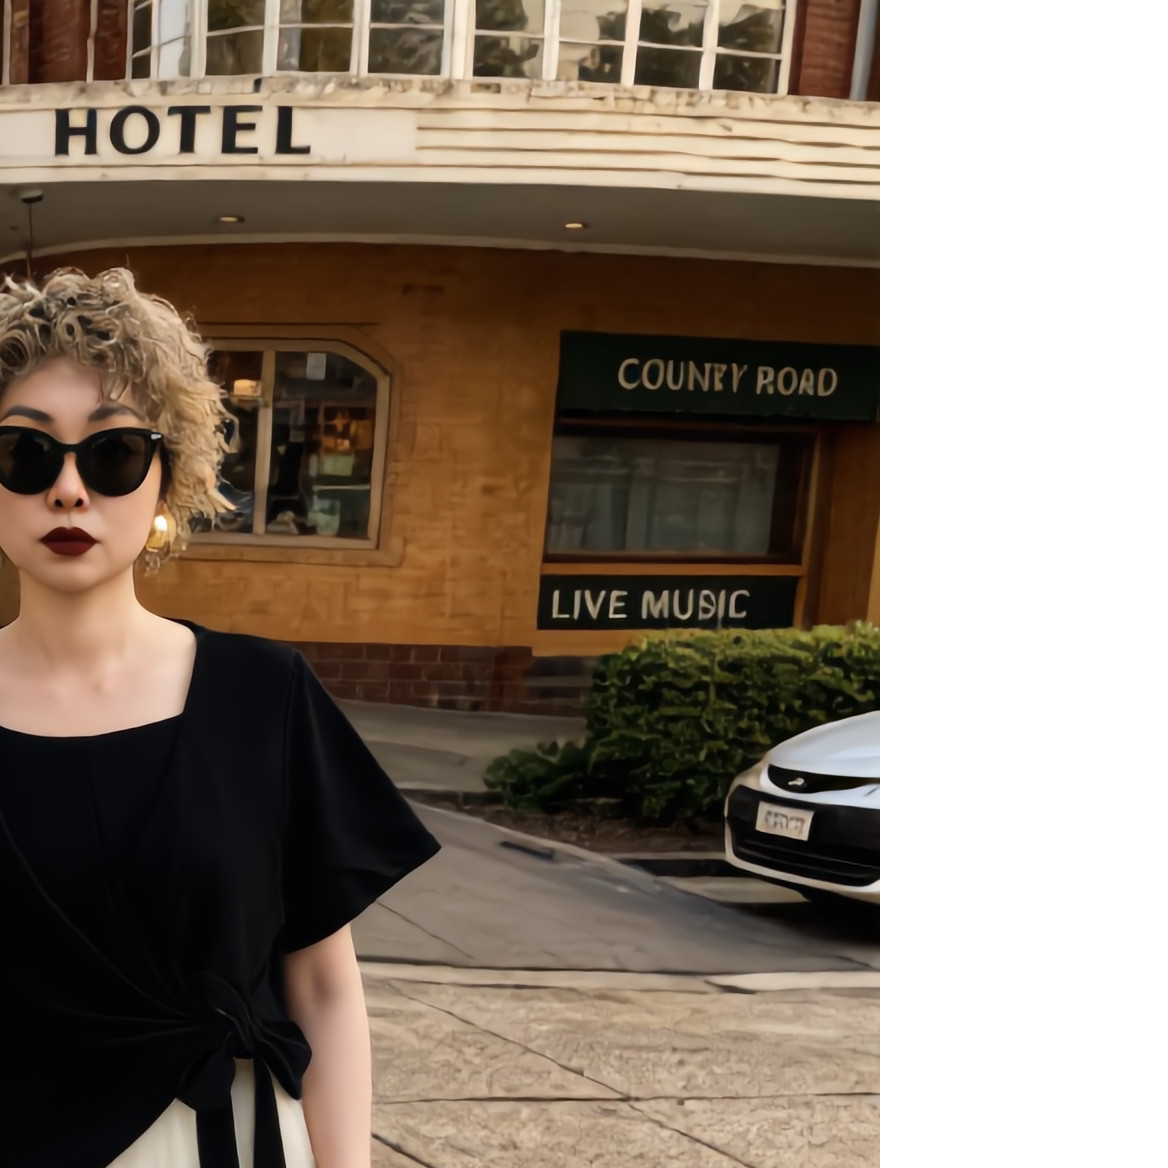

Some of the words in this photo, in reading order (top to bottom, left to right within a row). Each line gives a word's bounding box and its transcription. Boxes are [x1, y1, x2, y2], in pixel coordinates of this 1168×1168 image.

[54, 104, 312, 156] HOTEL
[756, 365, 838, 397] ROAD
[552, 589, 629, 620] LIVE
